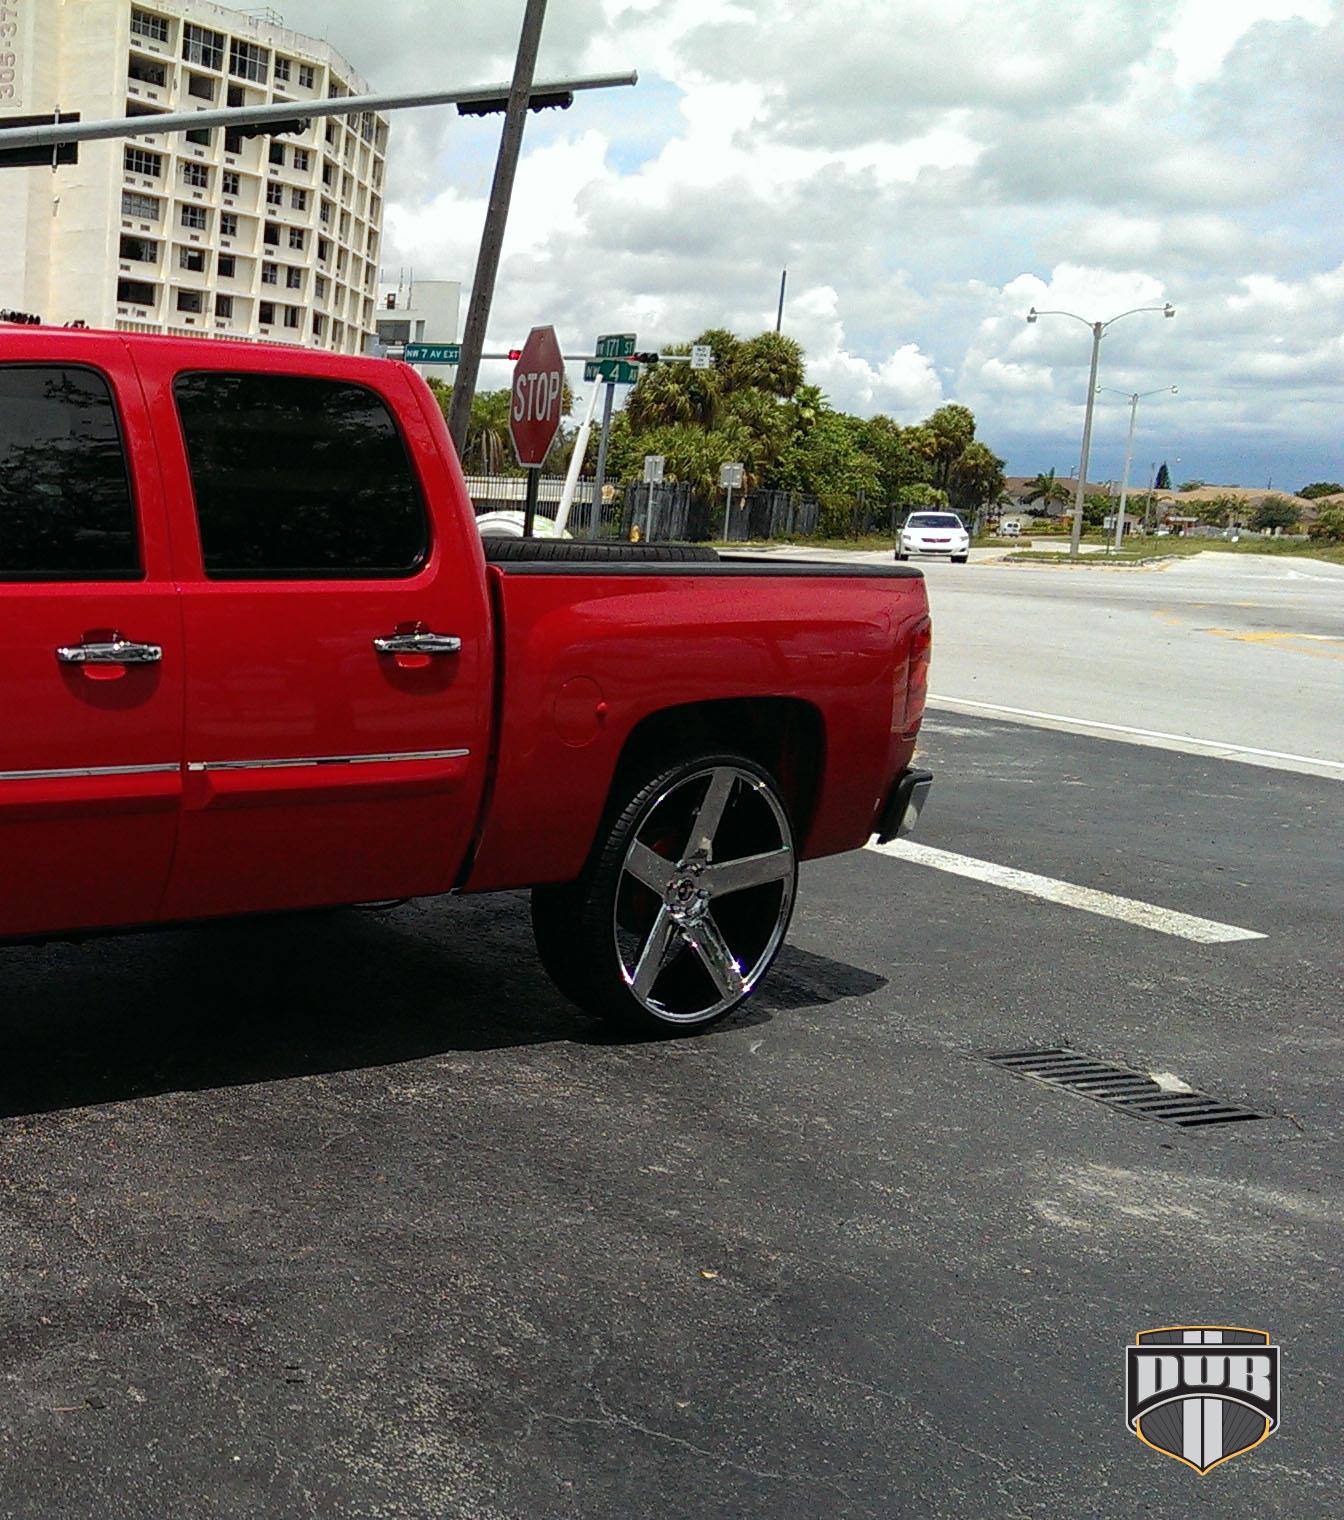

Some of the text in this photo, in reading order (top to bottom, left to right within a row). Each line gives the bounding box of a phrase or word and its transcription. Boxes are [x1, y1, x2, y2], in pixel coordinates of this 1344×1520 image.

[406, 349, 459, 358] NW 7 AV EXT
[609, 364, 620, 382] 4
[514, 371, 560, 421] STOP
